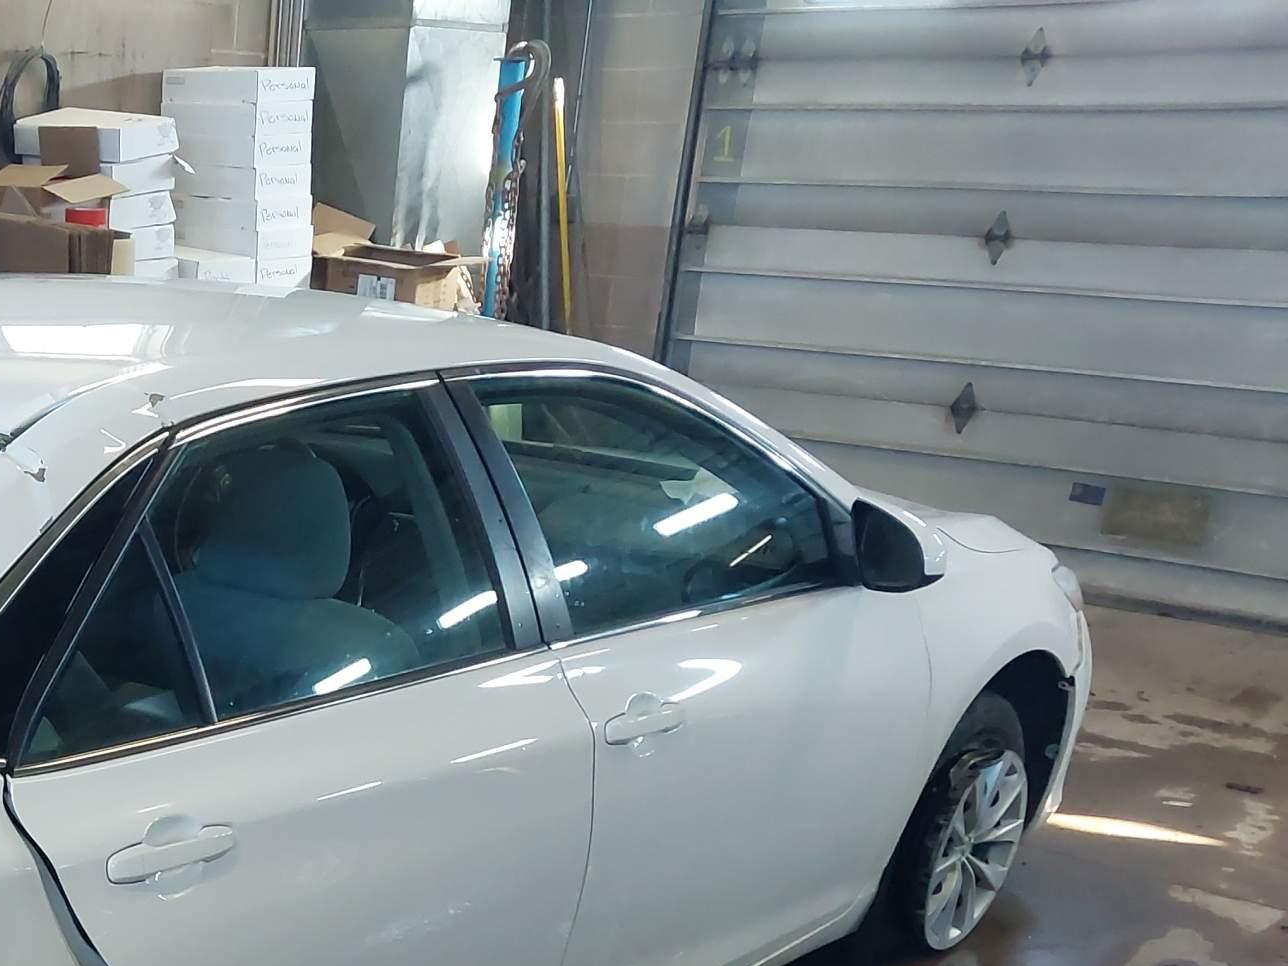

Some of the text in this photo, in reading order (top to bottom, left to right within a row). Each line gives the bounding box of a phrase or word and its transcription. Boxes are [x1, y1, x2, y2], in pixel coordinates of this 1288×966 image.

[261, 76, 310, 92] Personal
[259, 141, 302, 160] Personal
[713, 126, 736, 162] 1
